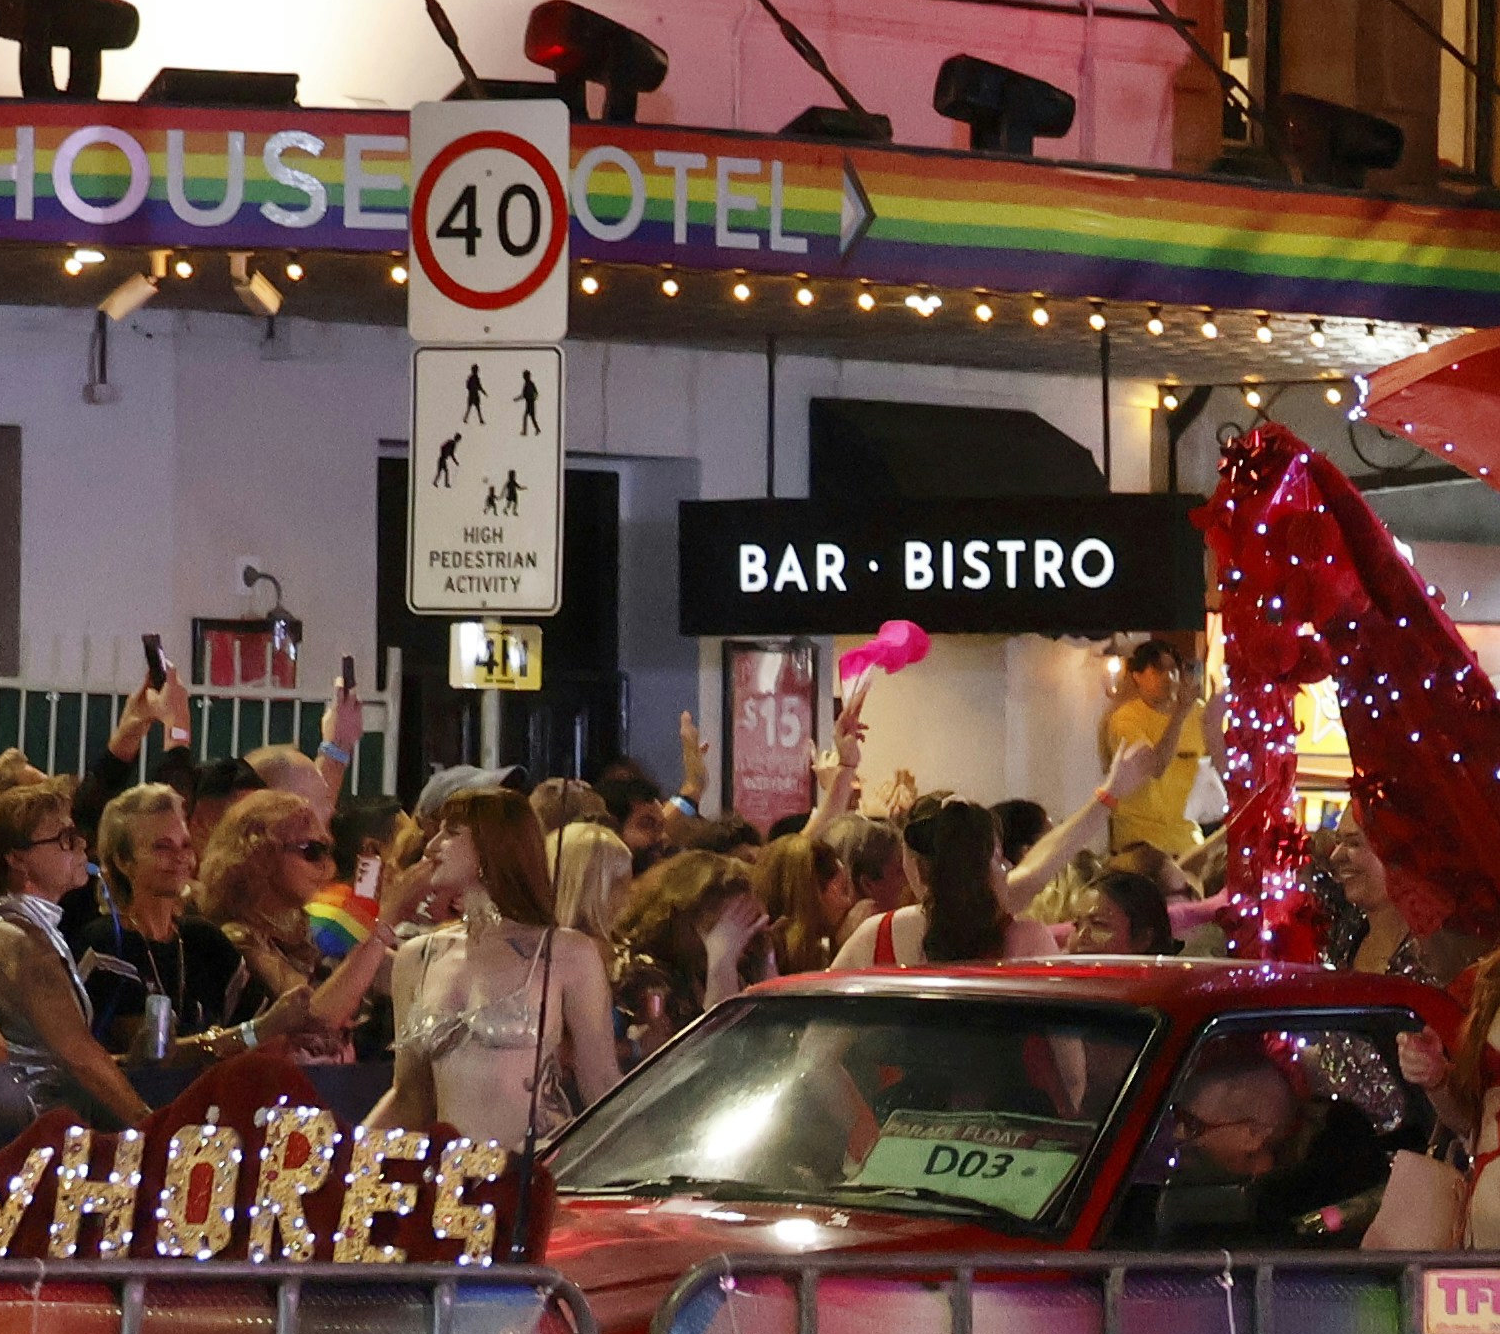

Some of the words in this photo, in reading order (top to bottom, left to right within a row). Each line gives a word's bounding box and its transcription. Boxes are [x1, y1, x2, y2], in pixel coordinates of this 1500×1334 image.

[572, 144, 809, 255] OTEL
[435, 182, 543, 259] 40
[462, 526, 504, 544] HIGH
[428, 550, 538, 570] PEDESTRIAN
[739, 541, 848, 593] BAR
[903, 537, 1115, 590] BISTRO
[443, 574, 521, 594] ACTIVITY
[743, 695, 801, 749] $15
[962, 1124, 1027, 1147] FLOAT
[924, 1143, 1015, 1180] D03
